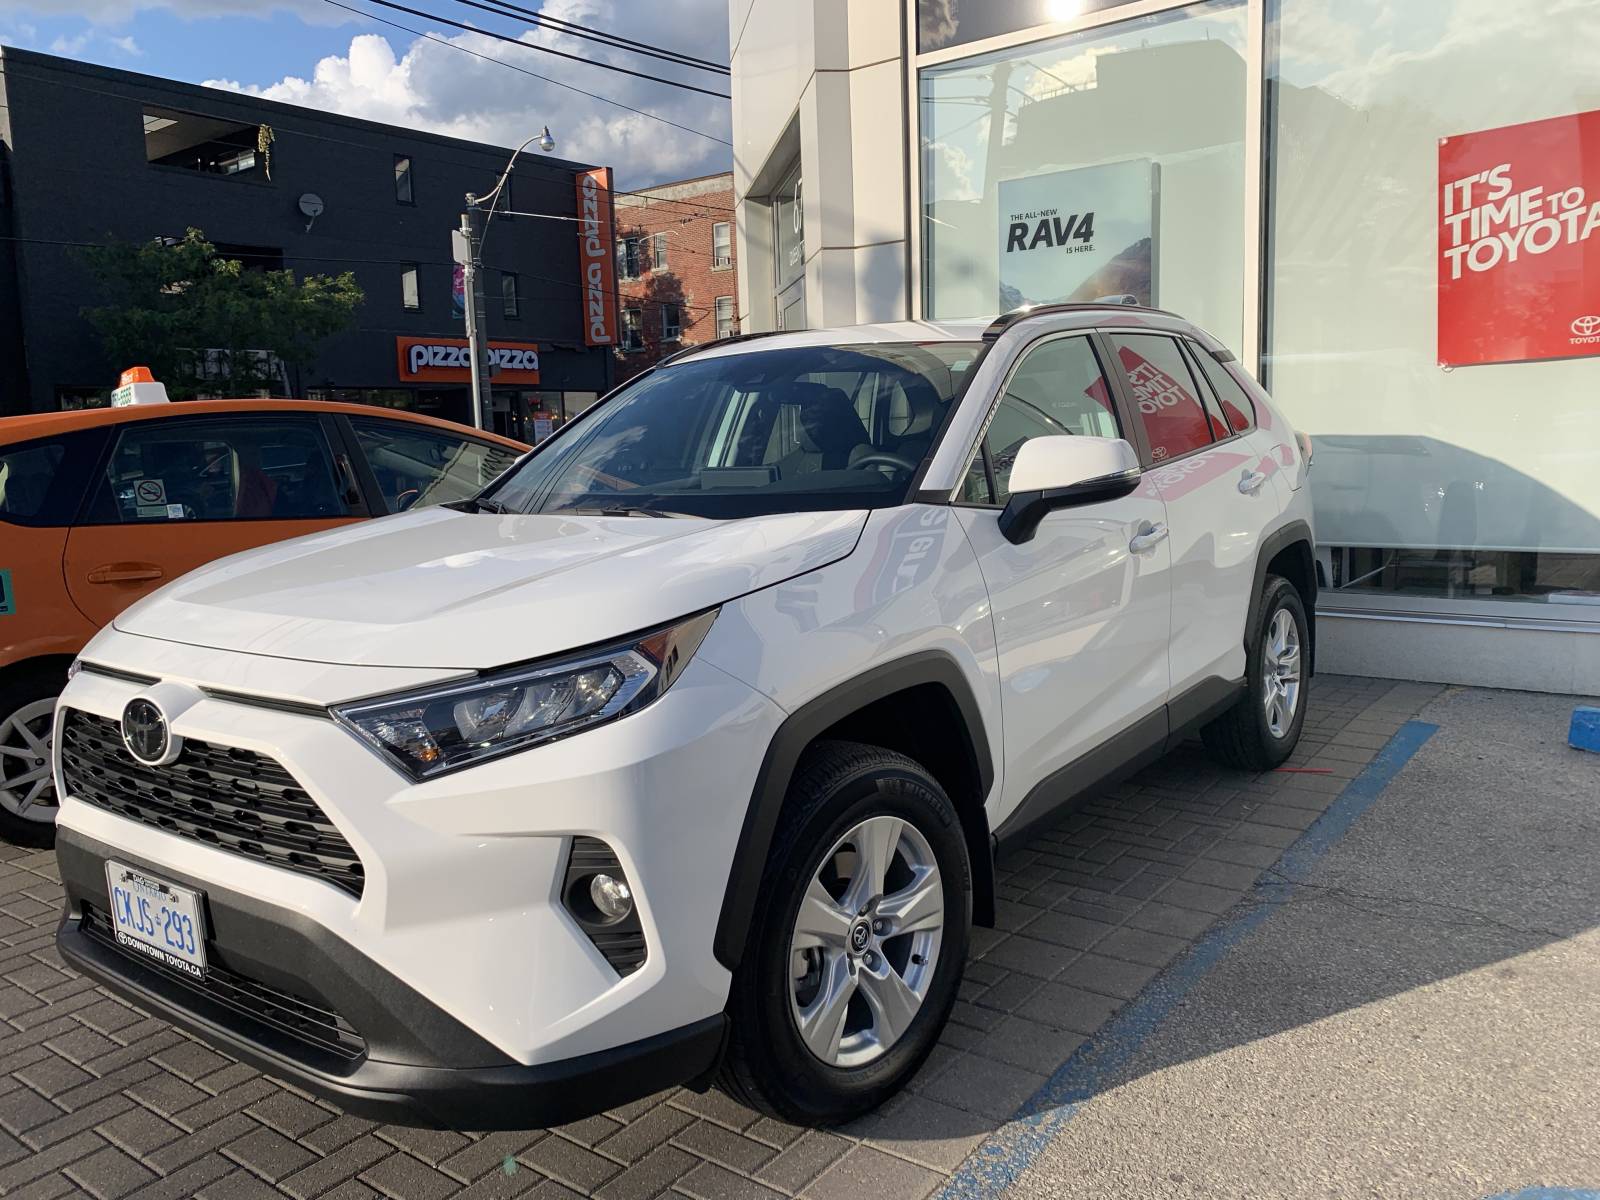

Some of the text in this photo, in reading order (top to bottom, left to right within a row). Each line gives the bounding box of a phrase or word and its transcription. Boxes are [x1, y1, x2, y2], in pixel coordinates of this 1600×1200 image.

[1024, 208, 1058, 219] ALL-NEW
[1445, 164, 1512, 216] IT'S
[1006, 212, 1094, 253] RAV4
[1445, 186, 1585, 247] TIME TO
[583, 175, 611, 343] pizza pizza
[1074, 245, 1096, 253] HERE.
[114, 887, 196, 955] CKJS 293
[127, 936, 202, 978] DOWNTOWN TOYOTA.CA
